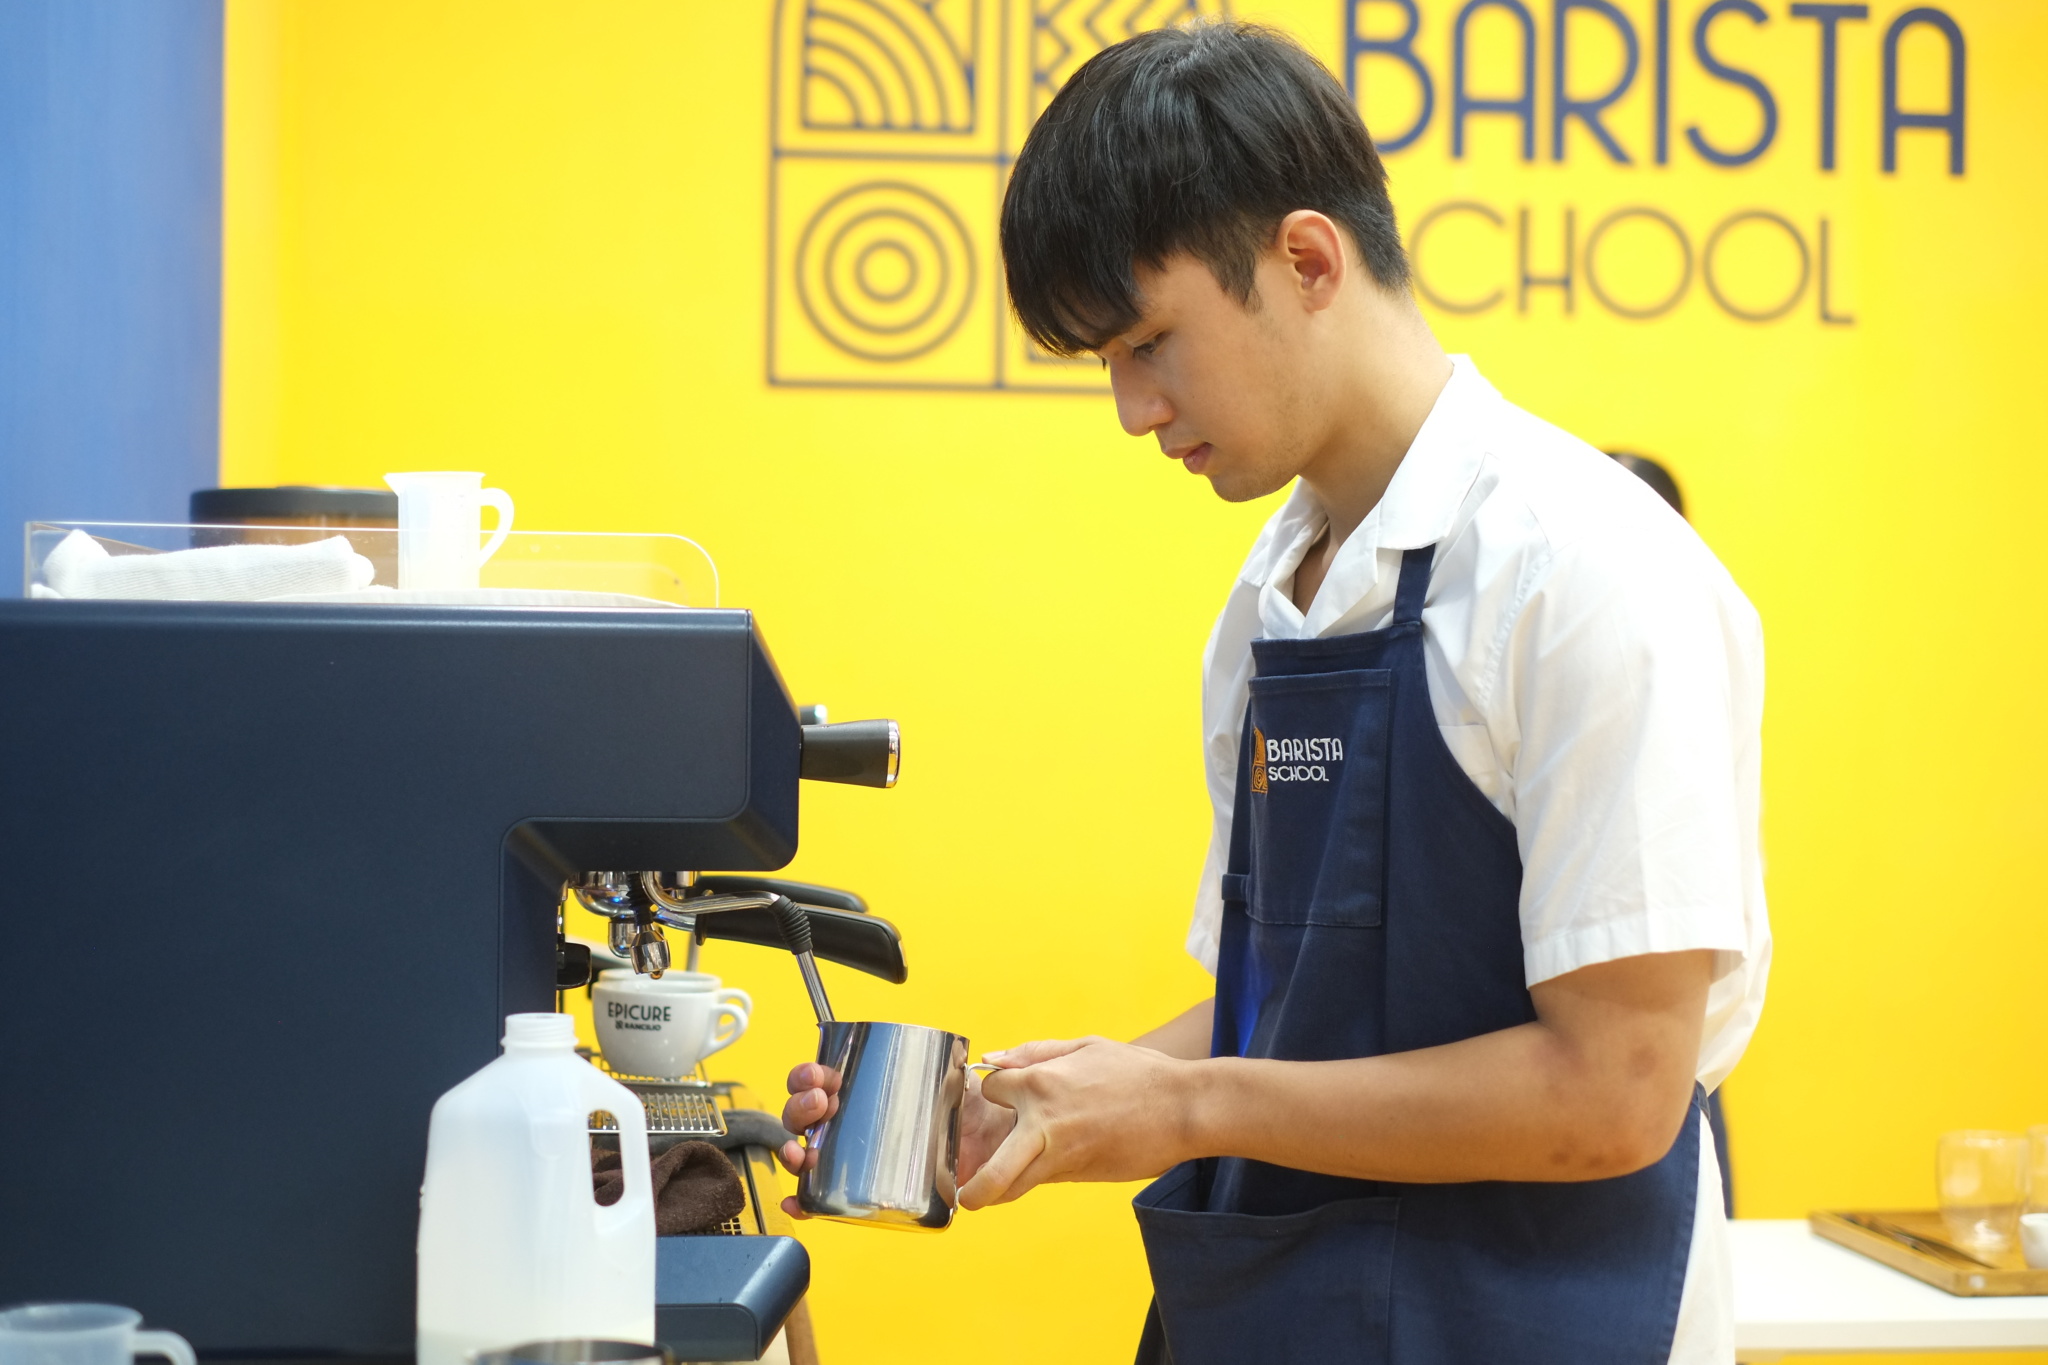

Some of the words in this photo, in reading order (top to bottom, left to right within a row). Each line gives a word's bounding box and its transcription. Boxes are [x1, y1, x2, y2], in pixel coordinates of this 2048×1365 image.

[1344, 0, 1967, 176] BARISTA
[1408, 200, 1856, 326] CHOOL
[1266, 738, 1343, 762] BARISTA
[1268, 766, 1329, 781] SCHOOL
[608, 1001, 671, 1022] EPICURE
[624, 1022, 661, 1031] RANCILIO
